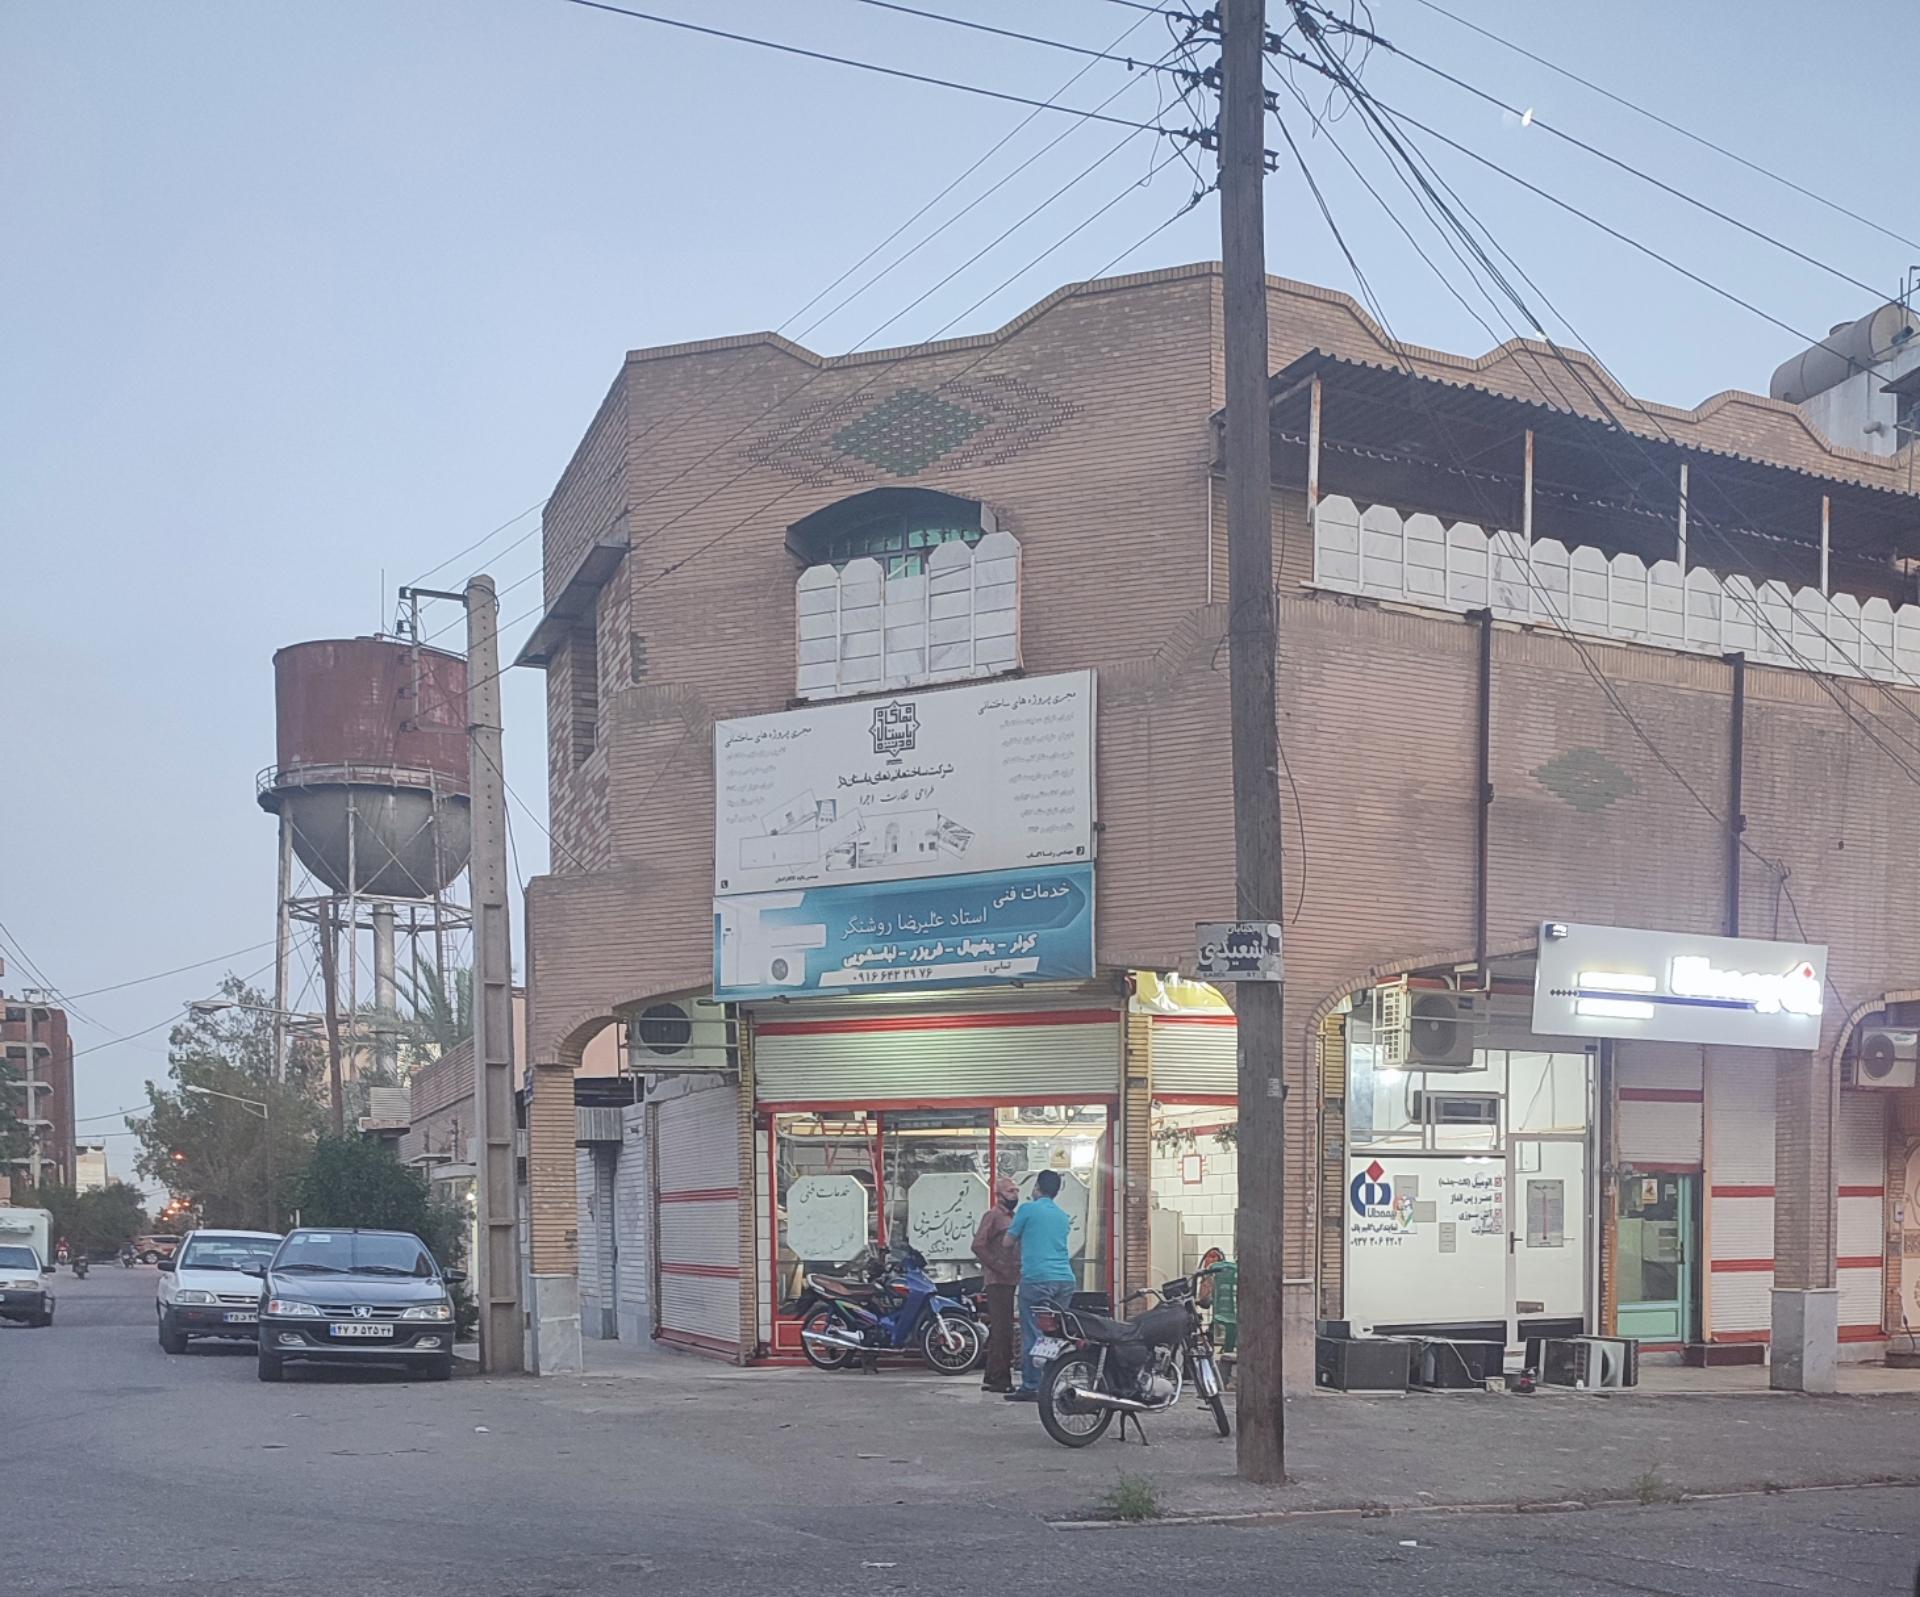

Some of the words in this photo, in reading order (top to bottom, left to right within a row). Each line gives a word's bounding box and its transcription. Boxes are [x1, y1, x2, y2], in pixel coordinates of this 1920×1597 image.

[927, 763, 954, 779] شرکت
[992, 886, 1017, 909] فنی
[1021, 882, 1070, 900] خدمات
[898, 910, 945, 934] علیرضا
[950, 906, 987, 926] استاد
[840, 914, 893, 940] روشنگر
[1227, 923, 1256, 936] خیابان
[909, 942, 944, 961] فریزر
[957, 938, 996, 958] یخچال
[1009, 932, 1038, 954] کولر
[853, 971, 879, 982] ۰۹۱۶
[799, 1181, 816, 1204] فنی
[816, 1184, 850, 1199] خدمات
[951, 1211, 976, 1240] اشین
